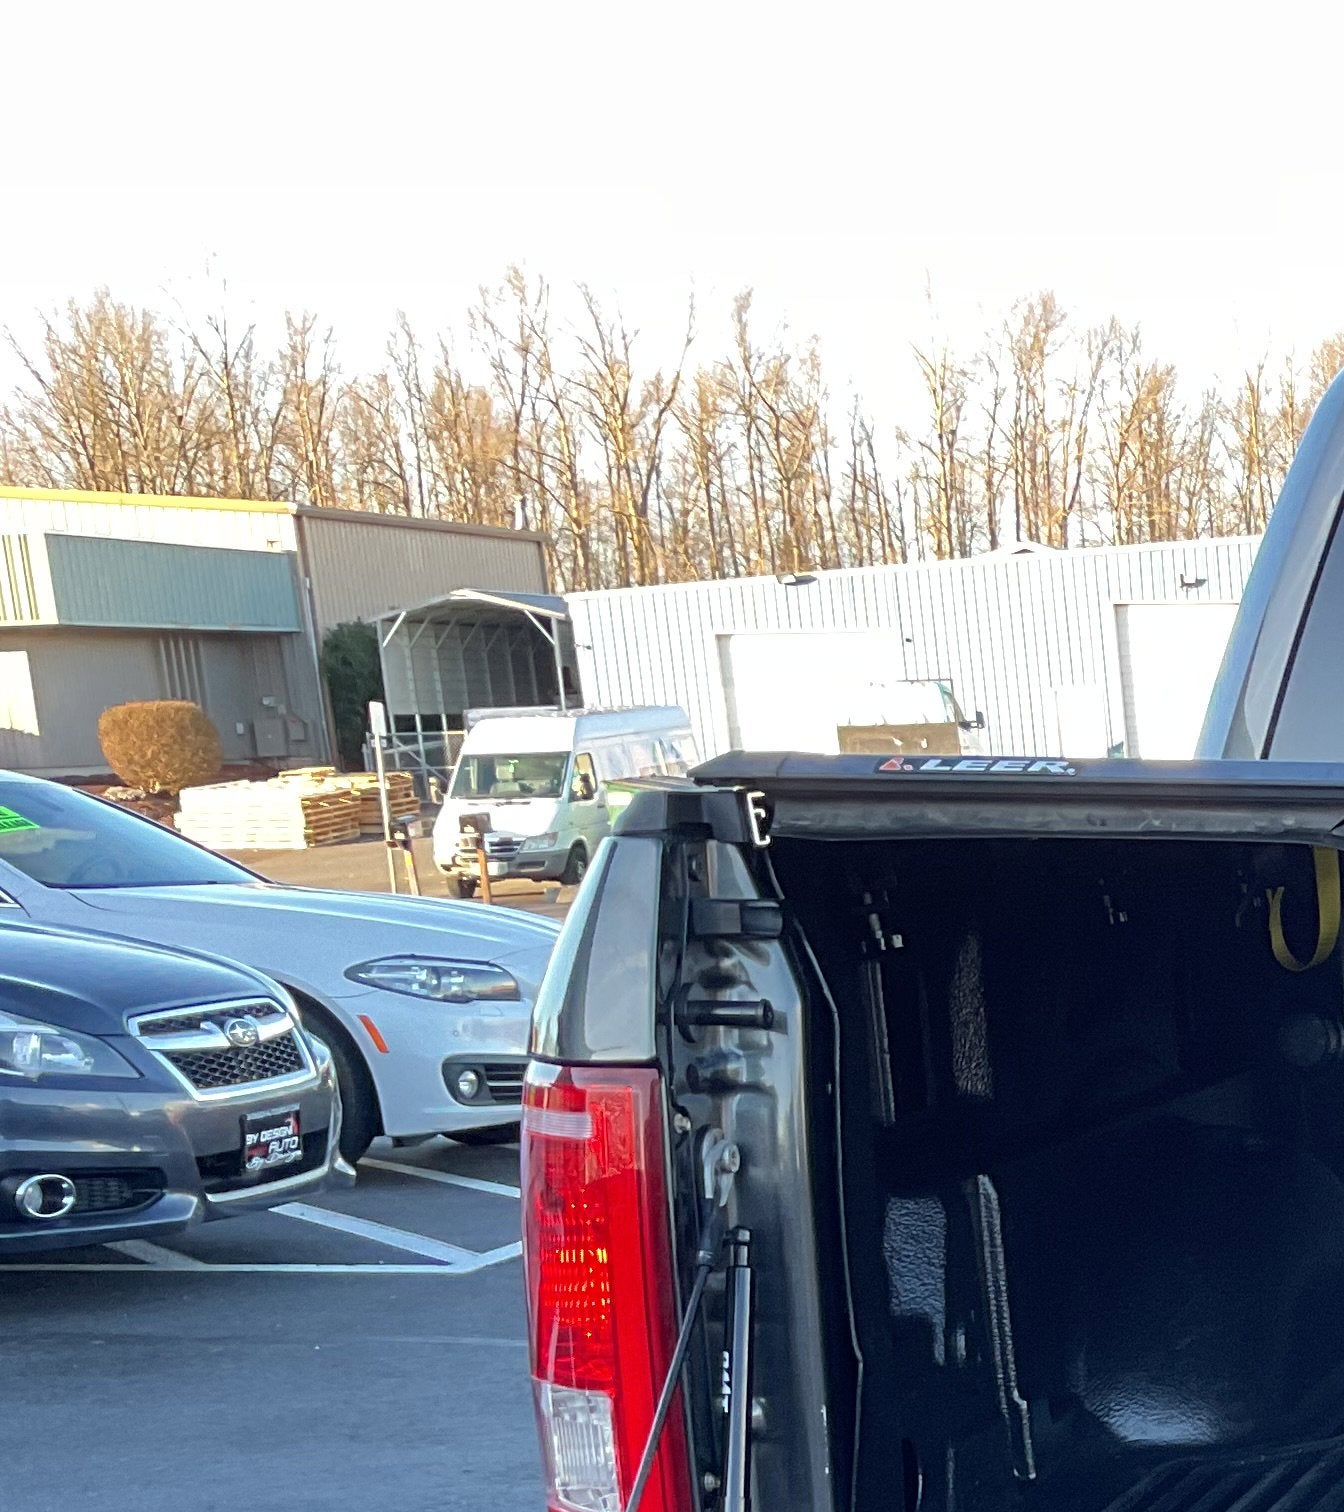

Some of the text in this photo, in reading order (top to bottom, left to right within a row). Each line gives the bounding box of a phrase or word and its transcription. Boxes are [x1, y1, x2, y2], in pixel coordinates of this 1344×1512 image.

[919, 758, 1070, 773] LEER
[246, 1133, 259, 1145] BY
[268, 1136, 299, 1153] AUTO
